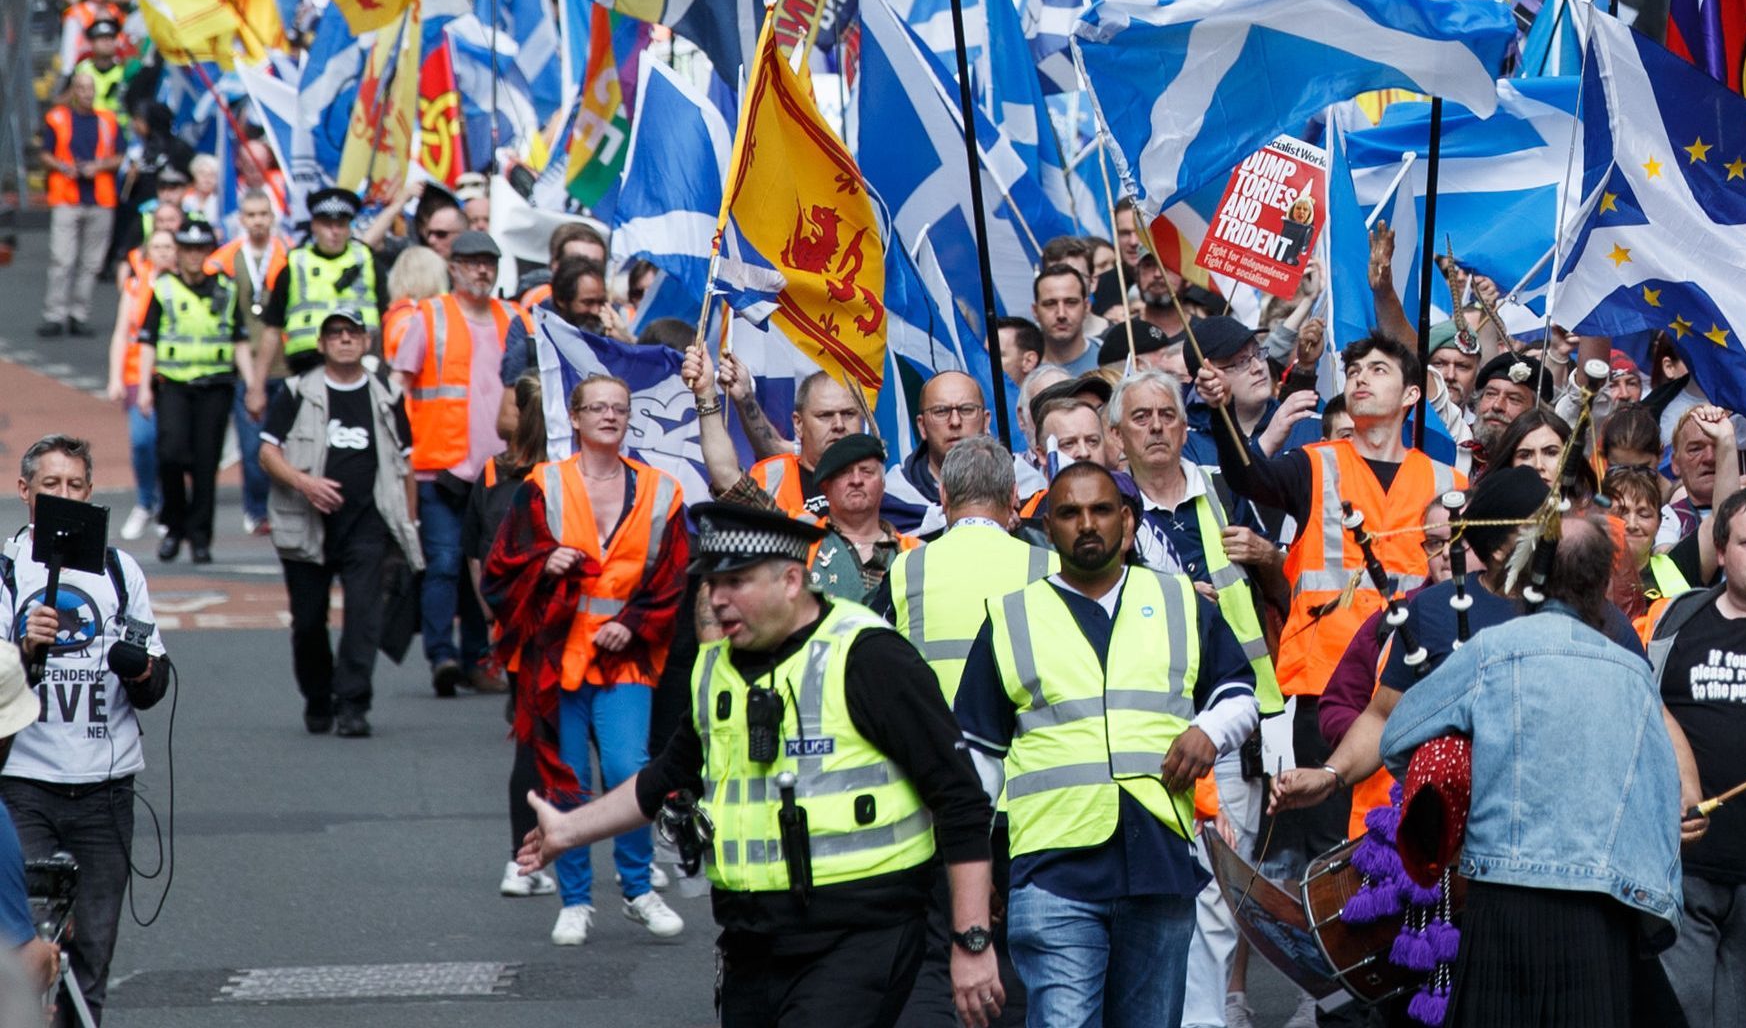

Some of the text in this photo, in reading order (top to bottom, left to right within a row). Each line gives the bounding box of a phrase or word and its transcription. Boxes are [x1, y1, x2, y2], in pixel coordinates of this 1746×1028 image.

[1241, 151, 1297, 184] DUMP
[1234, 169, 1298, 212] TORIES
[1221, 192, 1263, 224] AND
[1214, 214, 1293, 262] TRIDENT
[1203, 253, 1271, 288] Fight for socialism
[1208, 243, 1290, 282] Fight for independence
[1689, 663, 1734, 685] please
[1708, 648, 1723, 667] If
[42, 668, 104, 682] PENDENC
[1691, 682, 1706, 702] to
[1706, 681, 1730, 700] the
[38, 683, 108, 723] IVE
